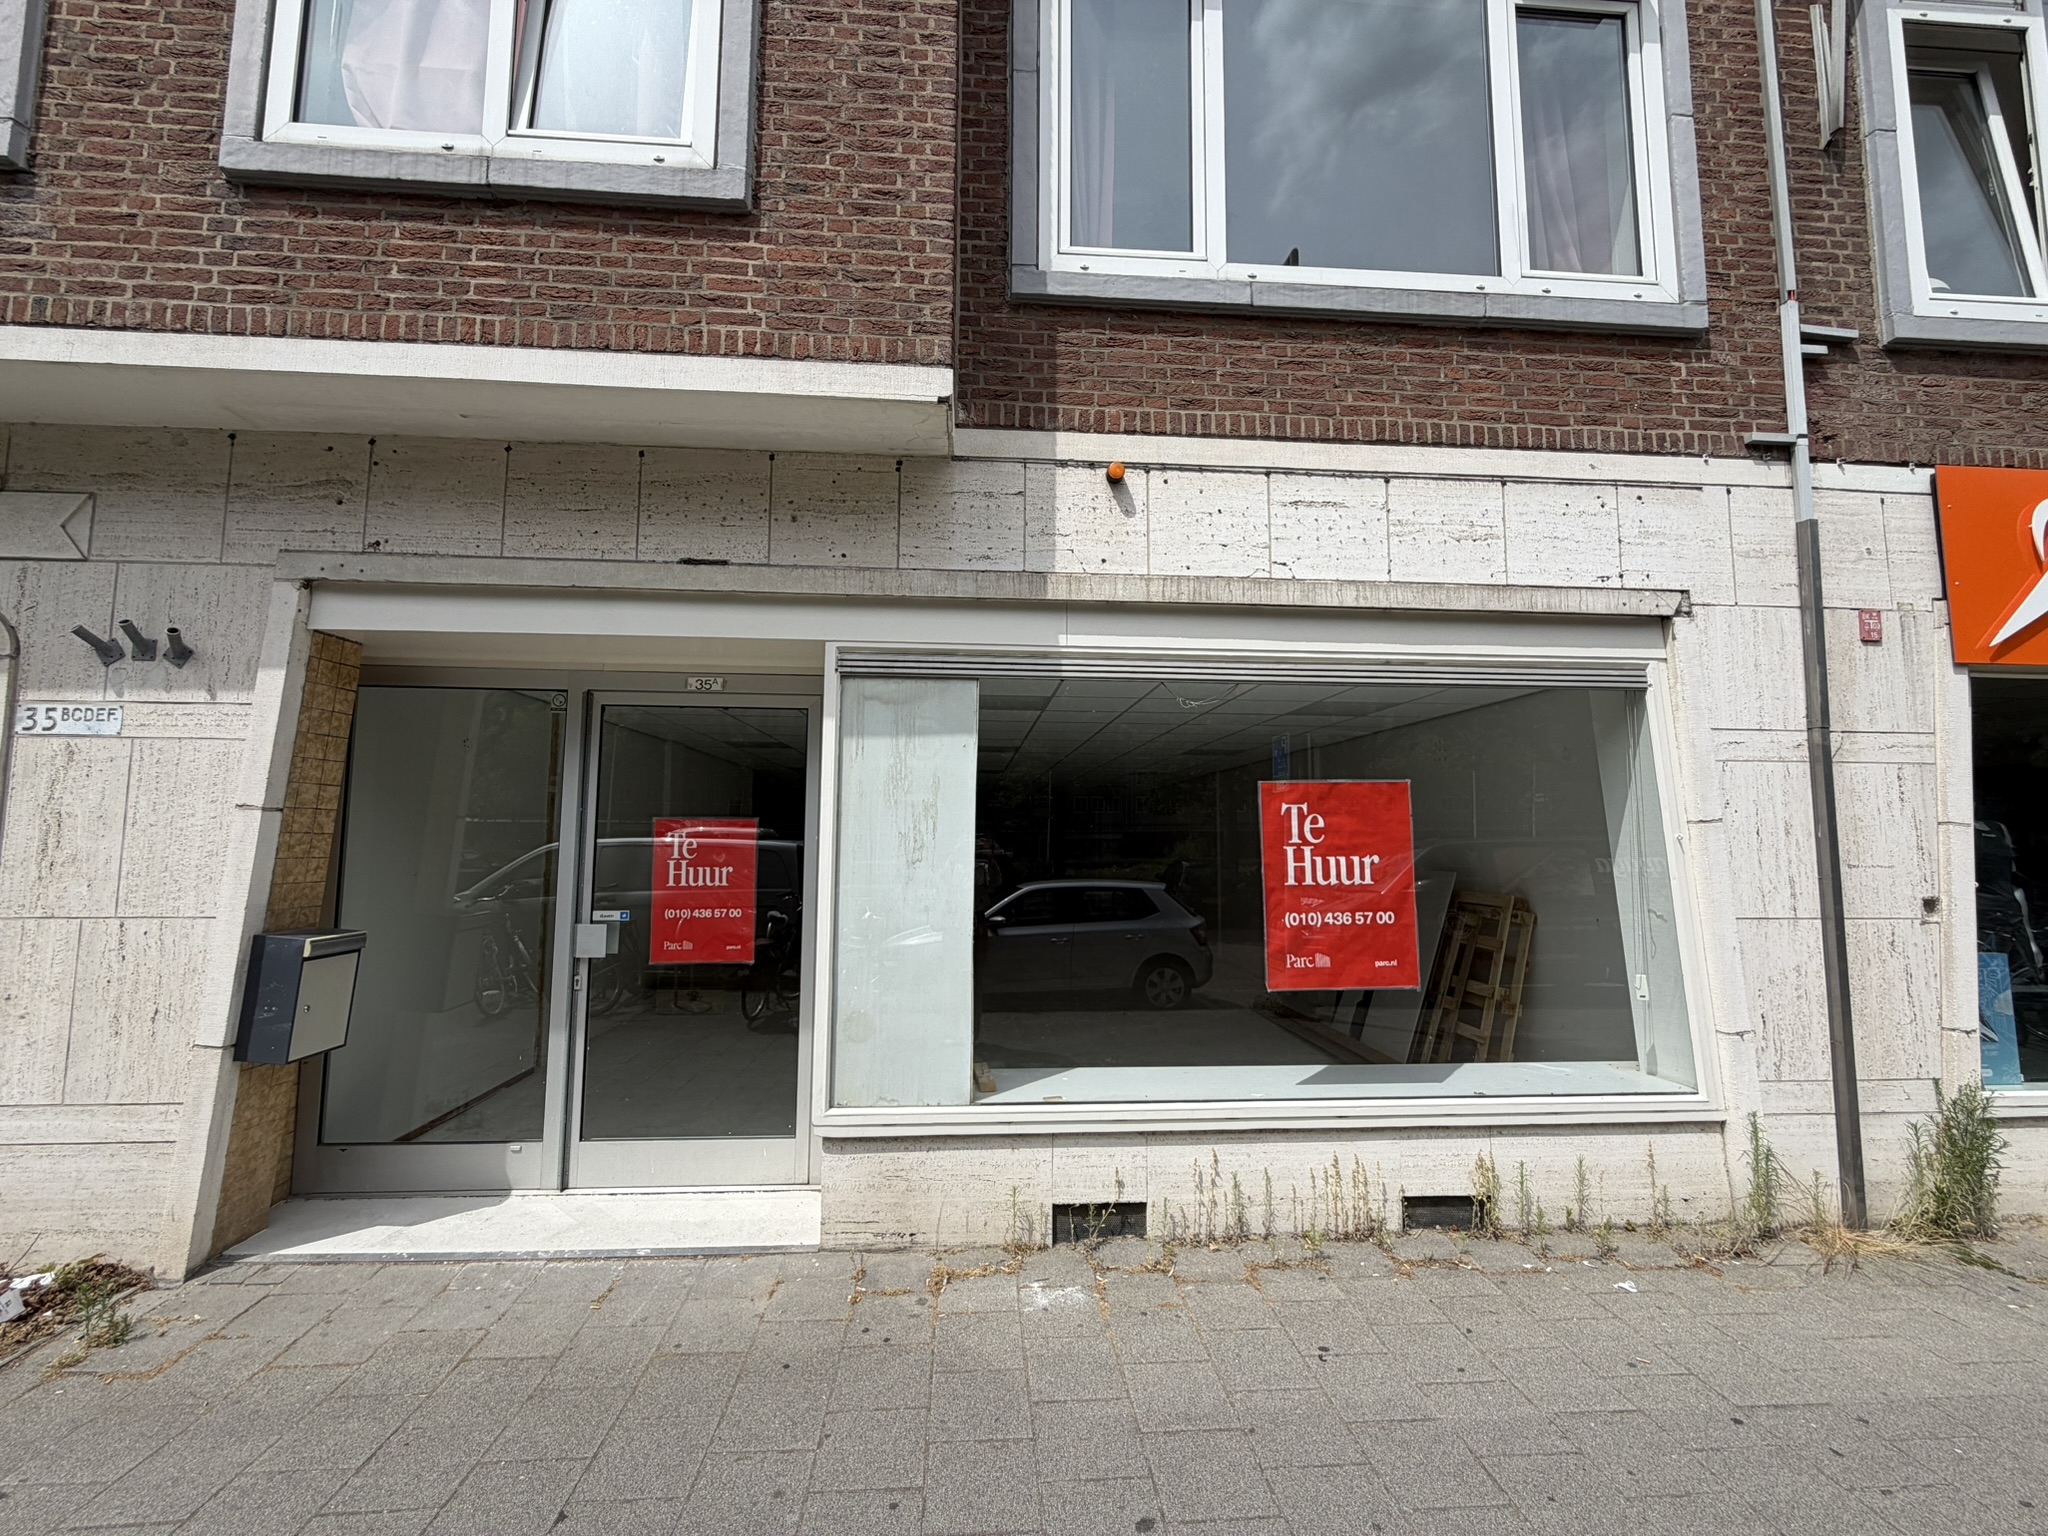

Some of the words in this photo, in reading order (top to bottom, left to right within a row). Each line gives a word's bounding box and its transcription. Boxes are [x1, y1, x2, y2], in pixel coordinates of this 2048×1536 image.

[1280, 801, 1326, 844] Te
[667, 831, 698, 859] Te
[665, 860, 734, 887] Huur
[1282, 845, 1380, 886] Huur
[664, 908, 691, 920] (010)
[692, 908, 712, 918] 436
[714, 908, 728, 918] 57
[728, 908, 742, 918] 00
[1284, 911, 1322, 928] (010)
[1324, 911, 1353, 925] 436
[1355, 911, 1374, 925] 57
[1376, 911, 1395, 925] 00
[663, 941, 682, 950] Parc
[1286, 953, 1315, 969] Parc
[1374, 959, 1398, 969] parc.nl
